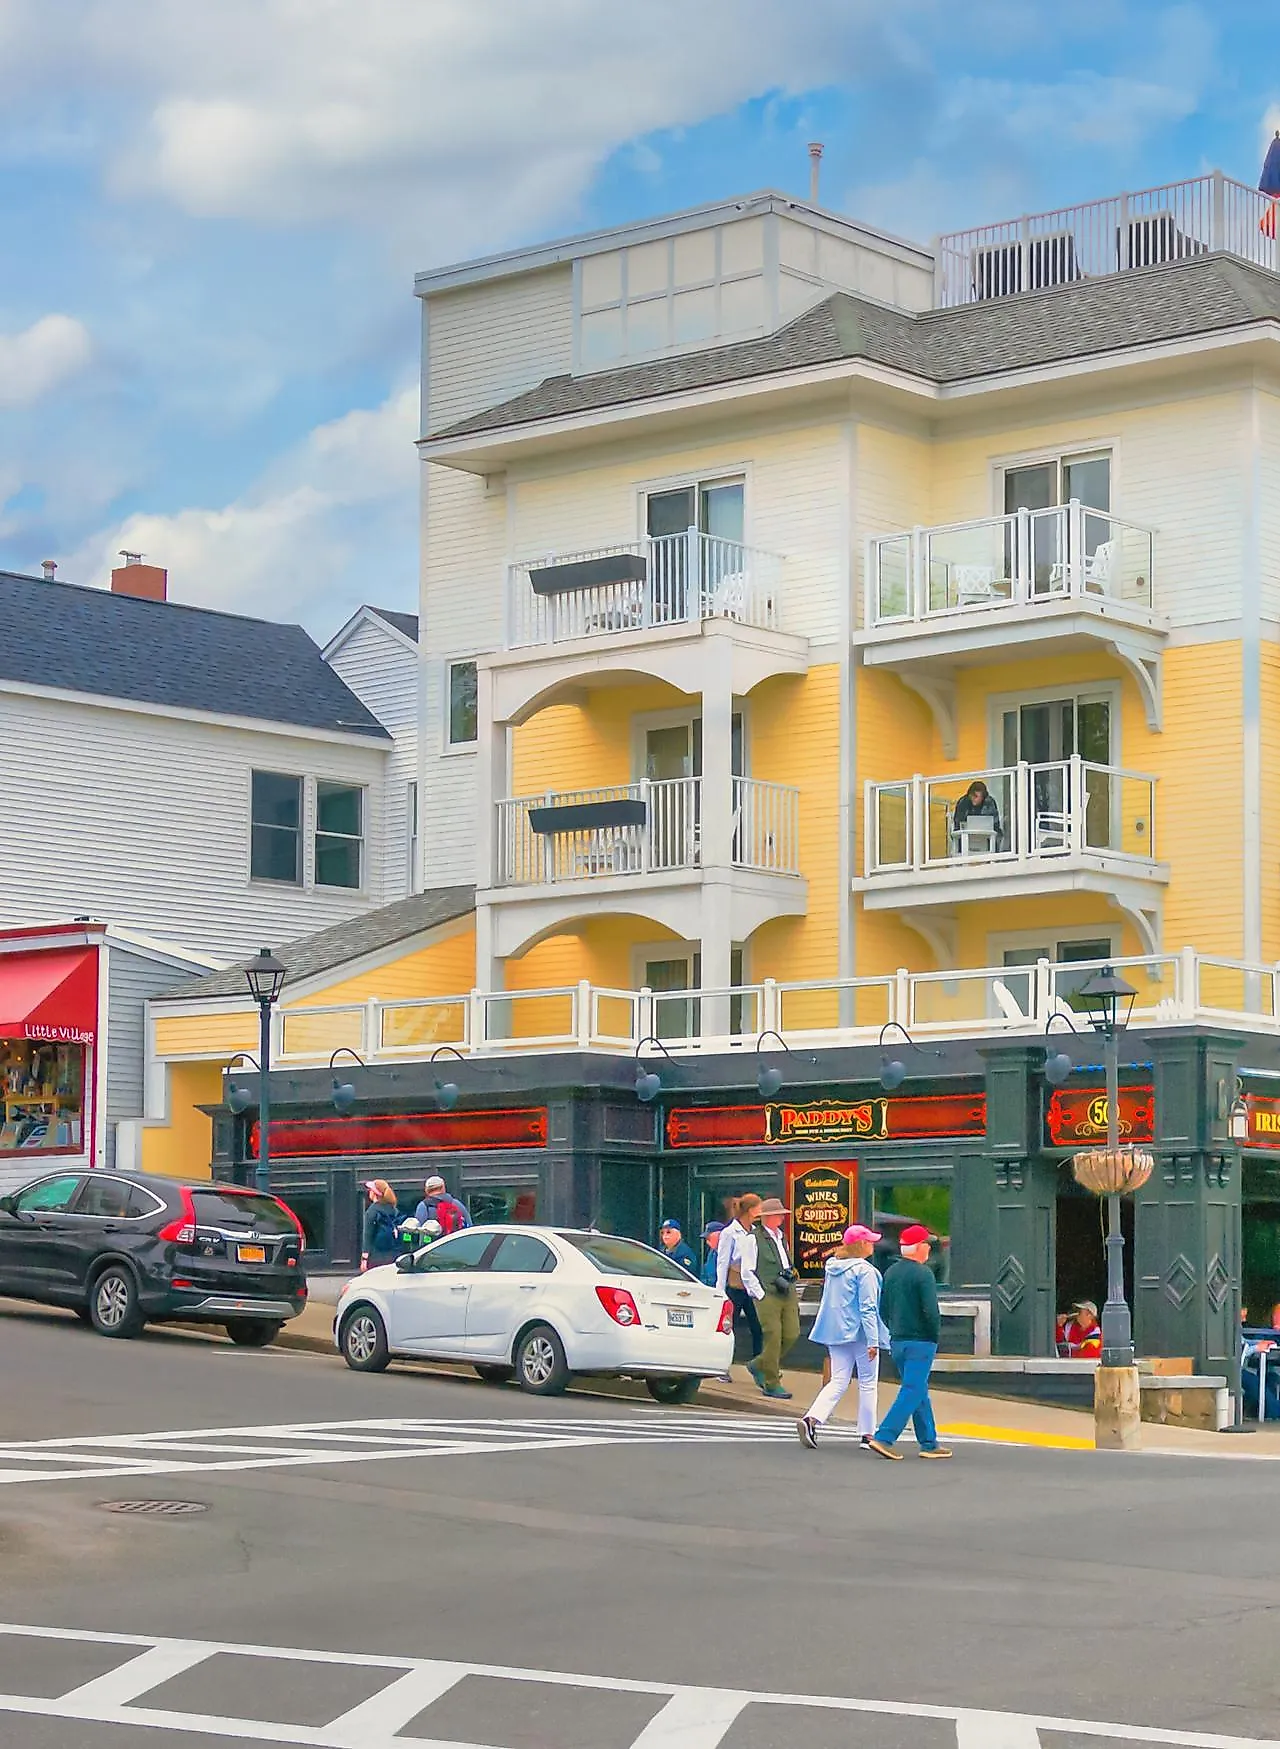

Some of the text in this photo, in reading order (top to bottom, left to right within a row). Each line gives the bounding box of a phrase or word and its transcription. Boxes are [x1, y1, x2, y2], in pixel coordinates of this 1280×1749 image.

[25, 1024, 94, 1043] Little Village
[780, 1105, 872, 1135] PADDY'S
[805, 1191, 838, 1203] WINES
[804, 1209, 840, 1221] SPIRITS
[800, 1231, 843, 1244] LIQUEURS
